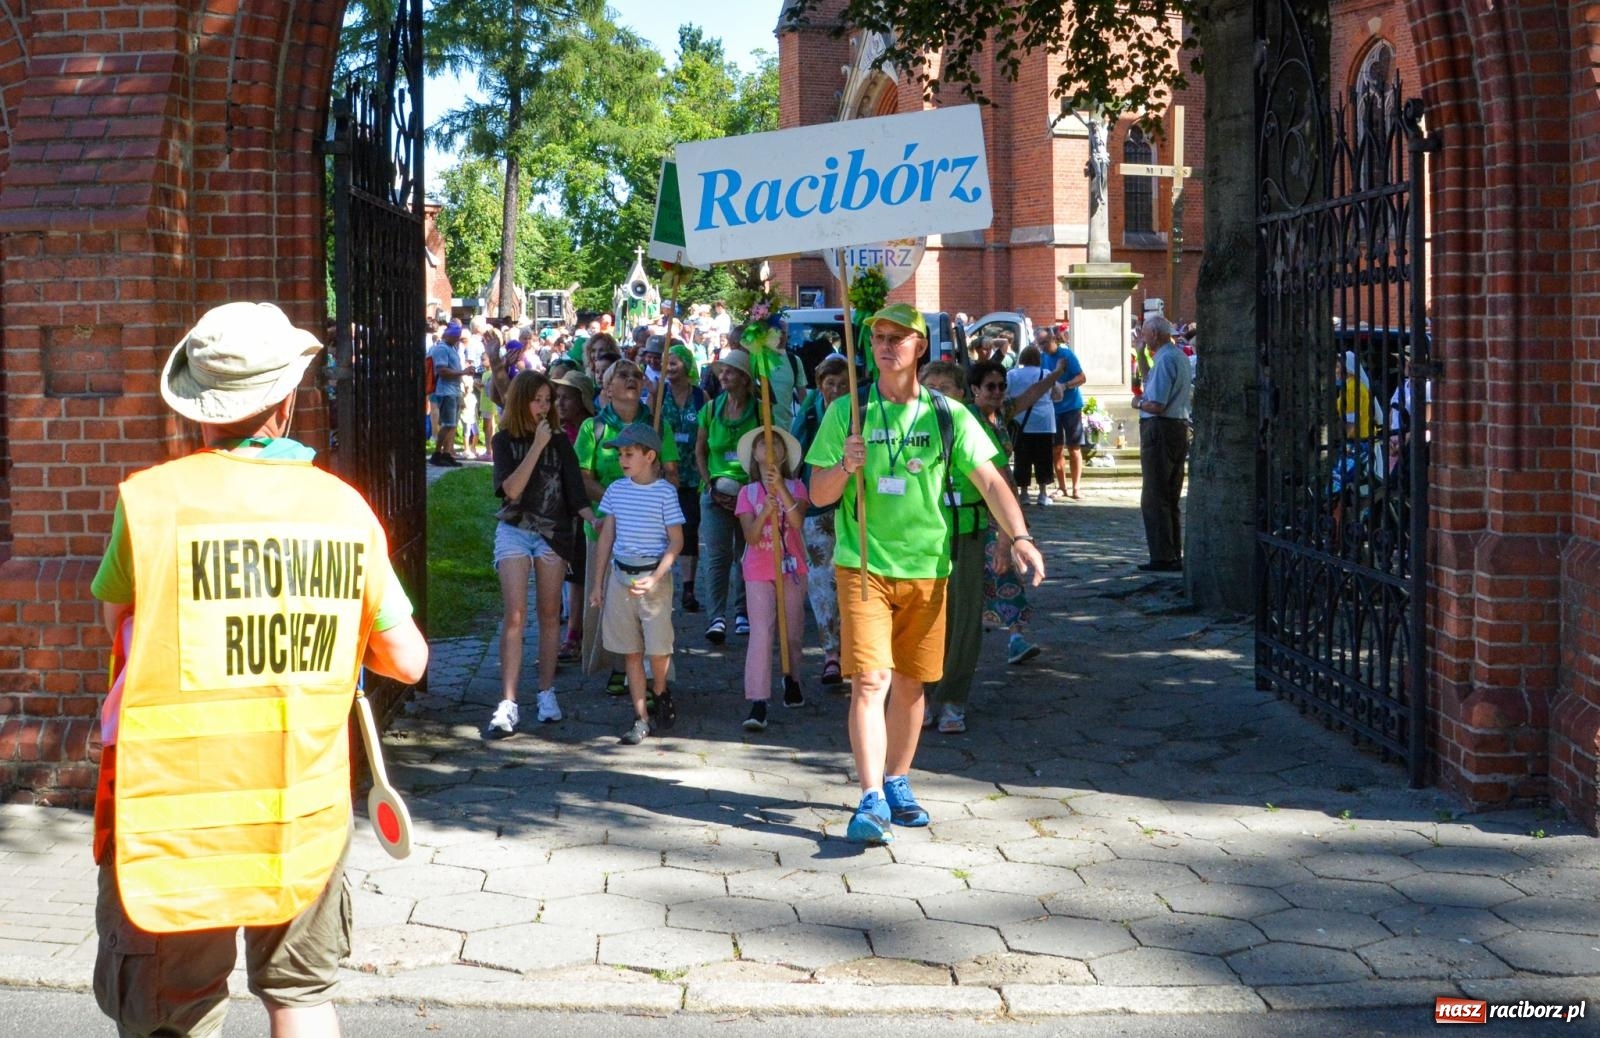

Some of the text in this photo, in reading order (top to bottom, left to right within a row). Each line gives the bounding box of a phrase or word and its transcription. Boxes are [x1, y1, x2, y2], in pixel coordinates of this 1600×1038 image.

[694, 142, 982, 231] Racibórz
[191, 538, 364, 600] KIEROWANIE
[226, 613, 338, 676] RUCHEM
